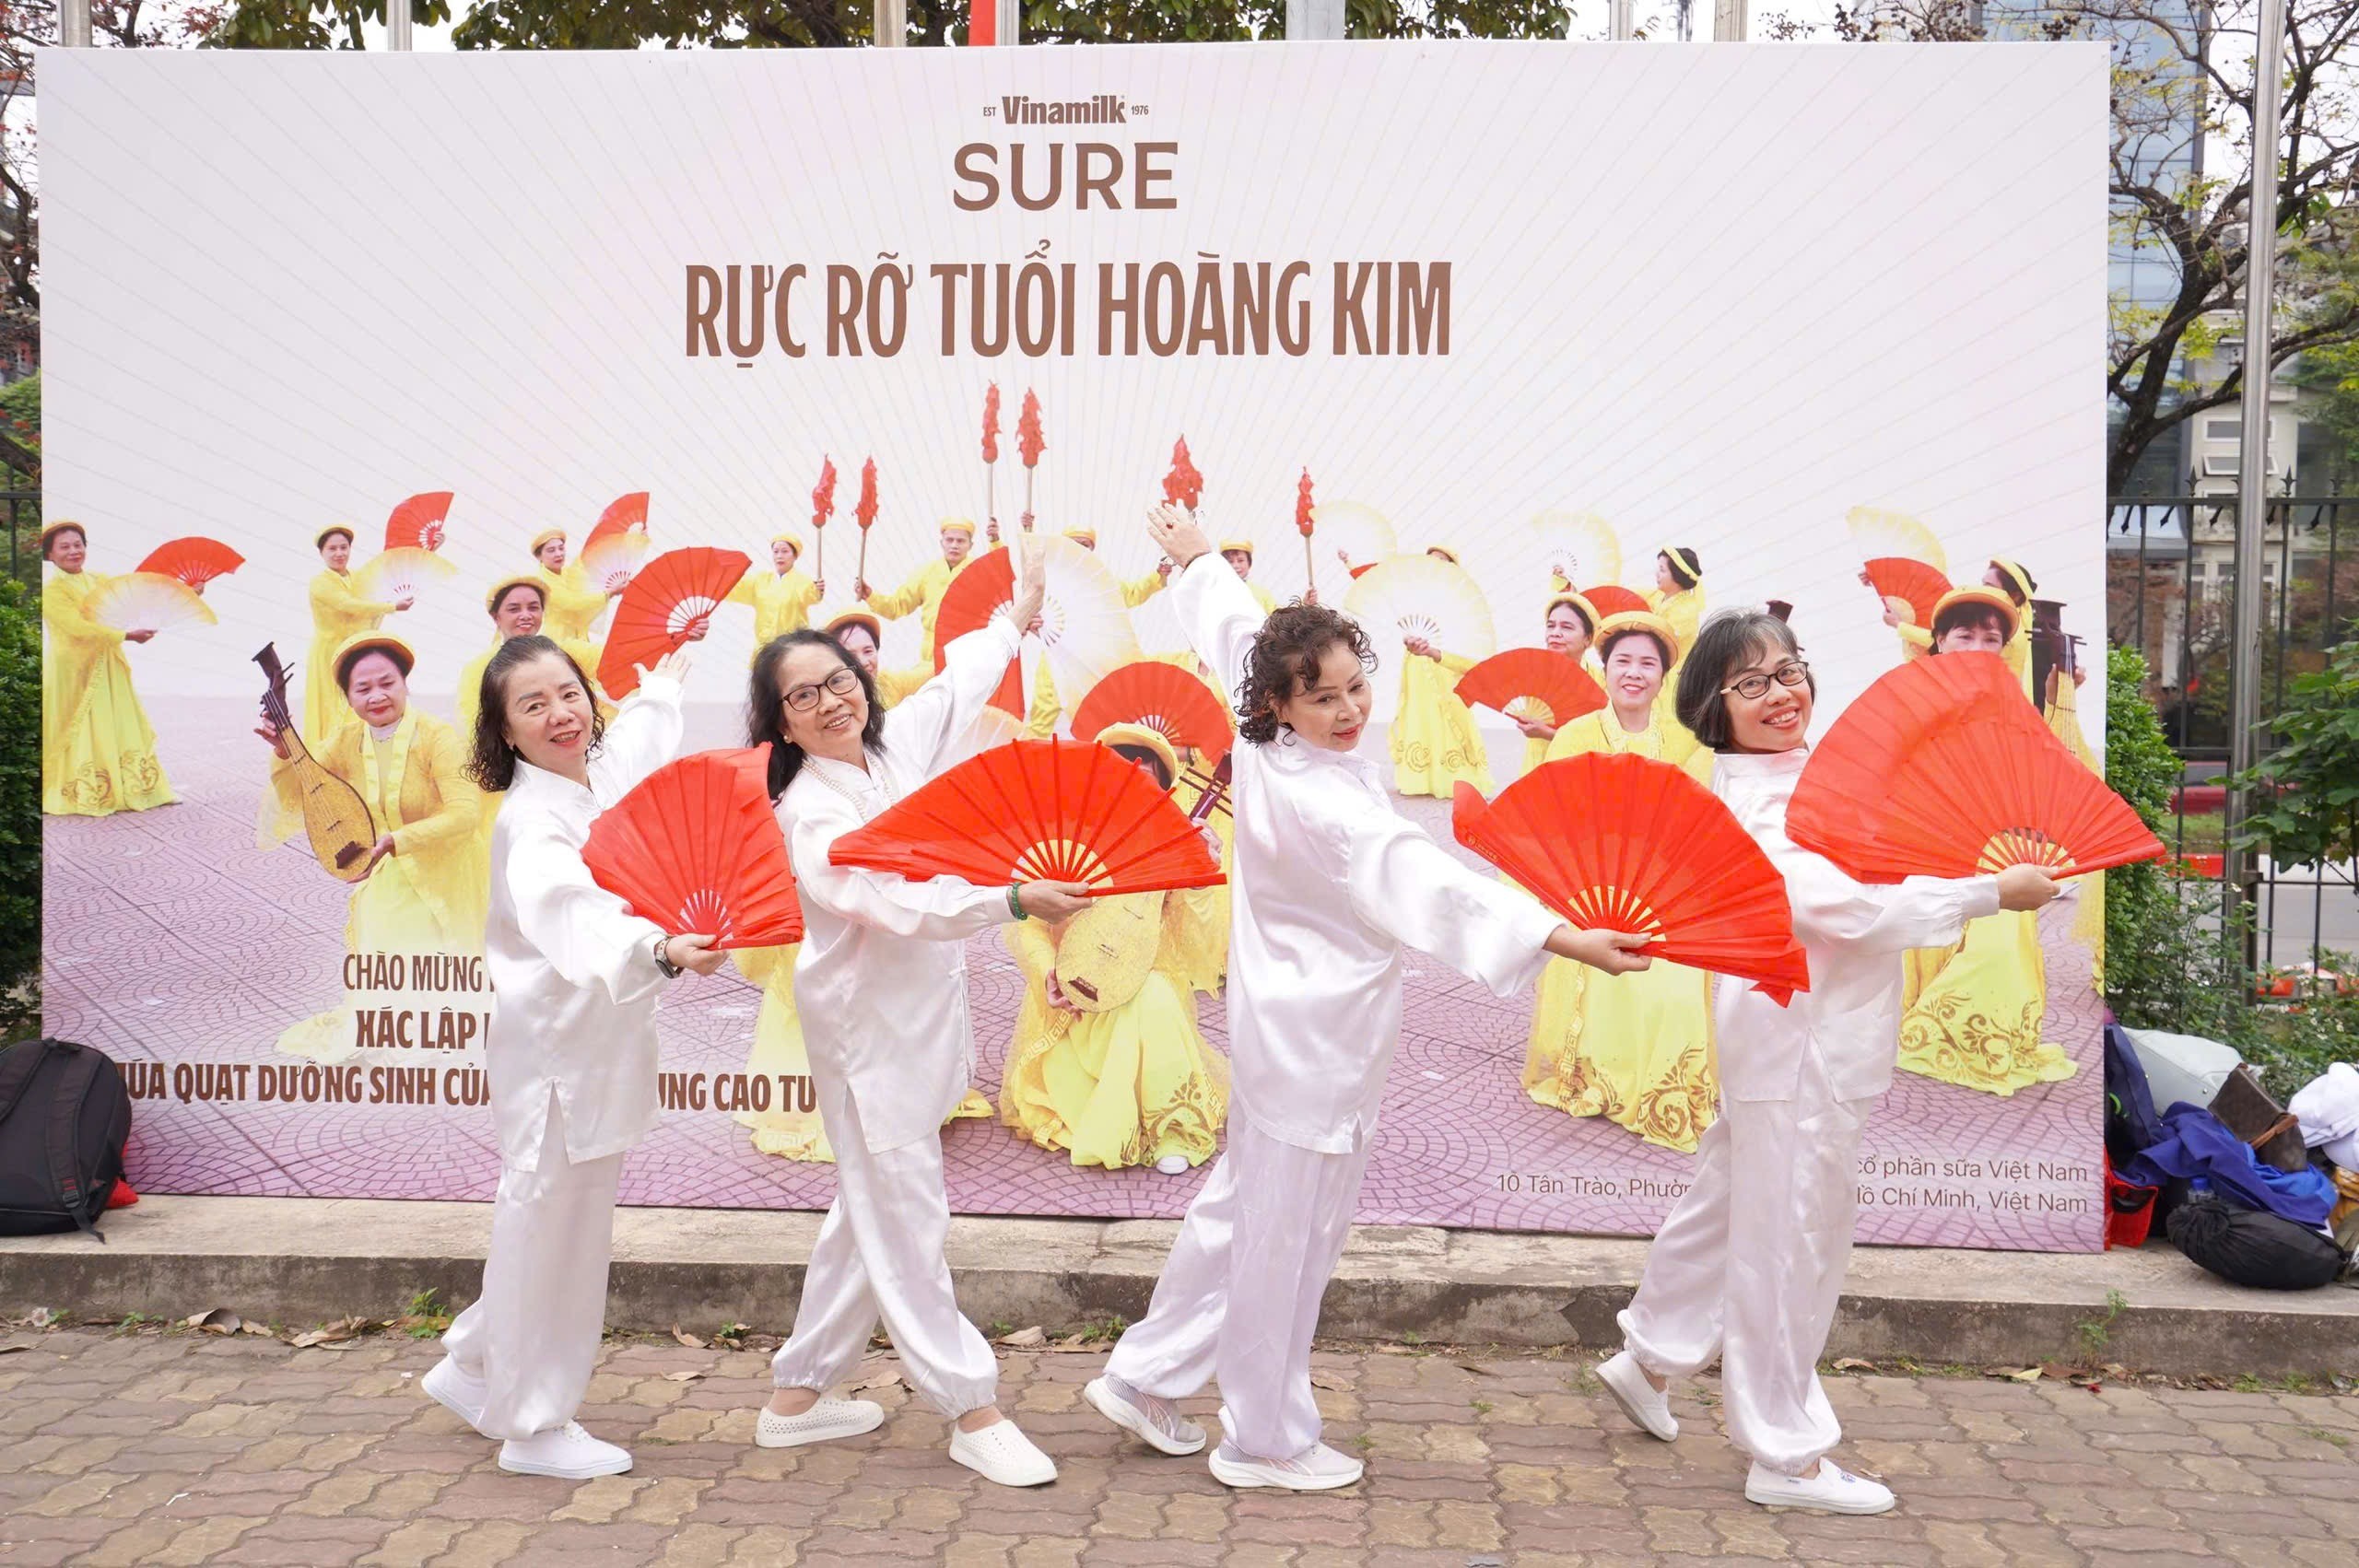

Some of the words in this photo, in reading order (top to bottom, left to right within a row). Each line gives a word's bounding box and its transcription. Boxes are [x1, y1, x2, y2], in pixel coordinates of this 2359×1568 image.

[983, 106, 996, 117] EST
[1002, 95, 1127, 124] Vinamilk
[1131, 105, 1149, 116] 1976
[954, 141, 1179, 211] SURE
[686, 263, 806, 368] RỰC
[826, 252, 913, 357] RỠ
[930, 239, 1075, 357] TUỔI
[1097, 251, 1310, 357] HOÀNG
[1332, 262, 1452, 357] KIM
[343, 951, 405, 991] CHÀO
[412, 952, 482, 992] MỪNG
[356, 1005, 414, 1049] XÁC
[420, 1005, 477, 1054] LẬP
[173, 1062, 251, 1106] QUẠT
[257, 1060, 362, 1104] DƯỠNG
[369, 1066, 437, 1105] SINH
[713, 1073, 771, 1113] CAO
[1883, 1154, 1936, 1179] phần
[1942, 1158, 1982, 1177] sữa
[1988, 1160, 2031, 1183] Việt
[2037, 1162, 2088, 1182] Nam
[1496, 1174, 1520, 1193] 10
[1526, 1174, 1565, 1194] Tân
[1569, 1175, 1623, 1199] Trào,
[1882, 1186, 1918, 1207] Chí
[1923, 1188, 1981, 1213] Minh,
[1988, 1189, 2031, 1214] Việt
[2037, 1192, 2088, 1213] Nam
